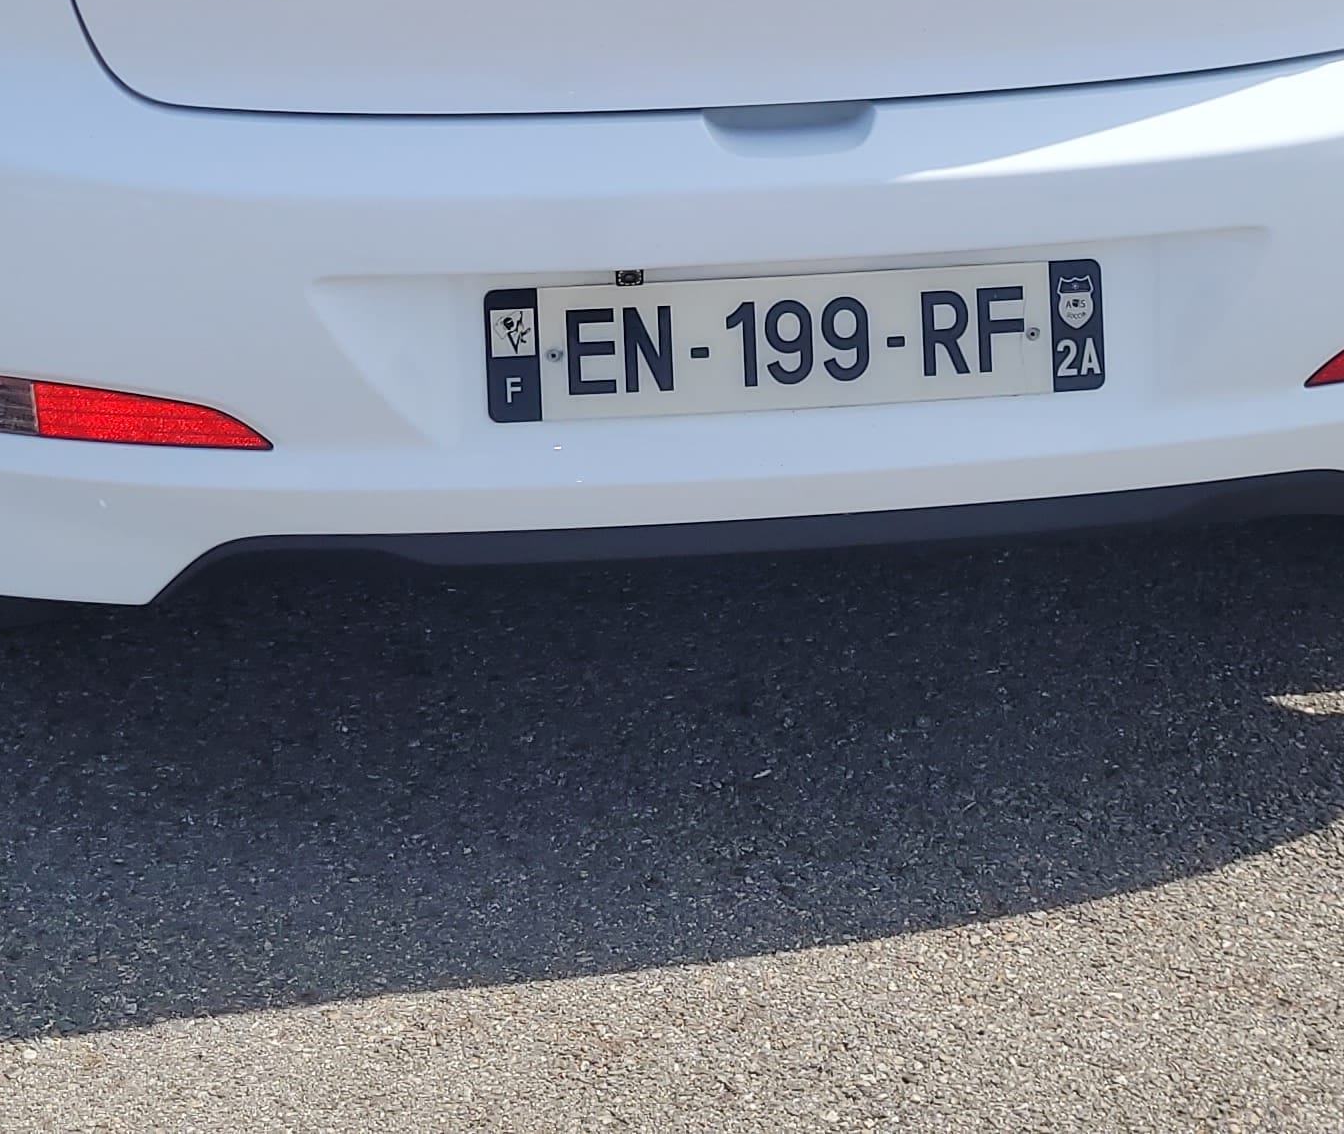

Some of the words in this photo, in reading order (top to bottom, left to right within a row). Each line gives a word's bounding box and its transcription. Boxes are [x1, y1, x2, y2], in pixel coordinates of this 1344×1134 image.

[565, 285, 1025, 395] EN-199-RF
[1057, 337, 1102, 377] 2A
[506, 377, 522, 403] F
